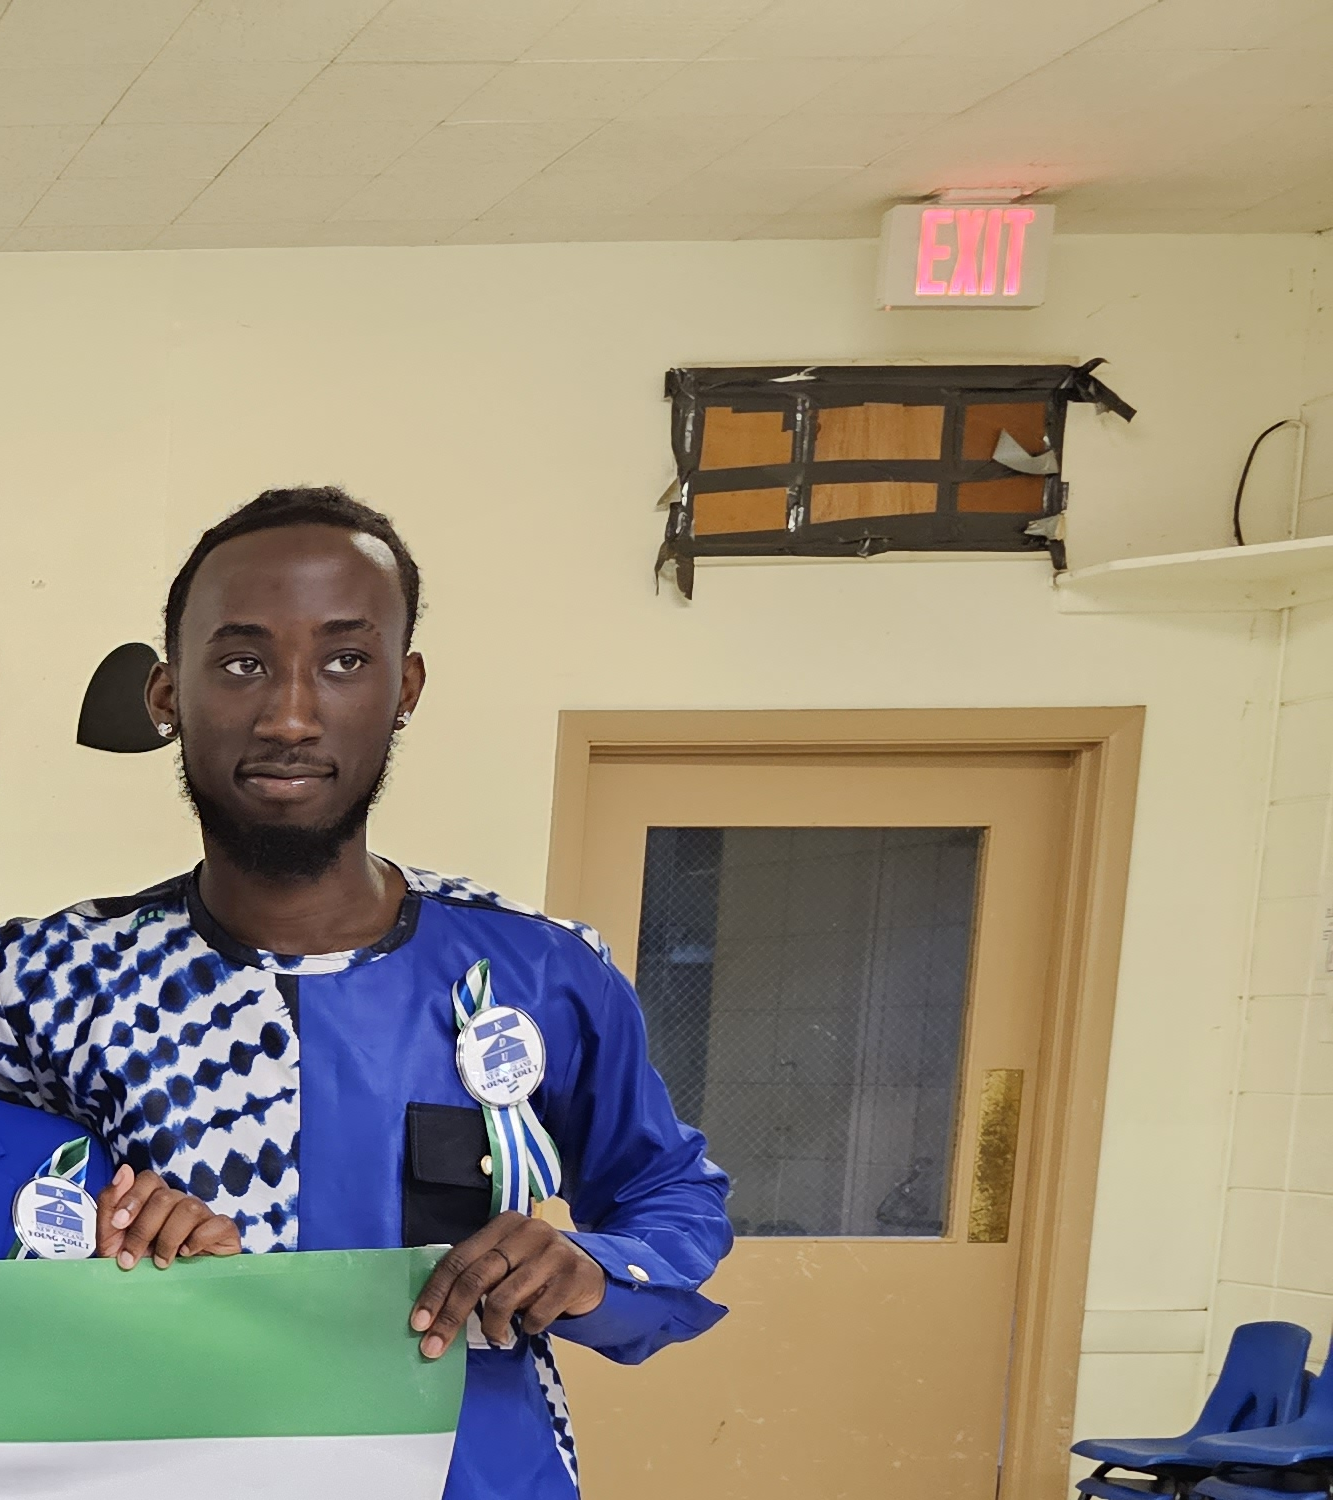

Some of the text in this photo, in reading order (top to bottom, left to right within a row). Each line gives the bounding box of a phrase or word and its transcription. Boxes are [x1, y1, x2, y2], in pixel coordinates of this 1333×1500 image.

[915, 208, 1035, 297] EXIT
[494, 1020, 503, 1032] K
[498, 1037, 507, 1048] D
[501, 1051, 509, 1062] U
[481, 1075, 510, 1091] YOUNG
[55, 1188, 65, 1198] K
[56, 1203, 65, 1212] D
[55, 1217, 64, 1226] U
[28, 1230, 91, 1250] YOUNG ADULT
